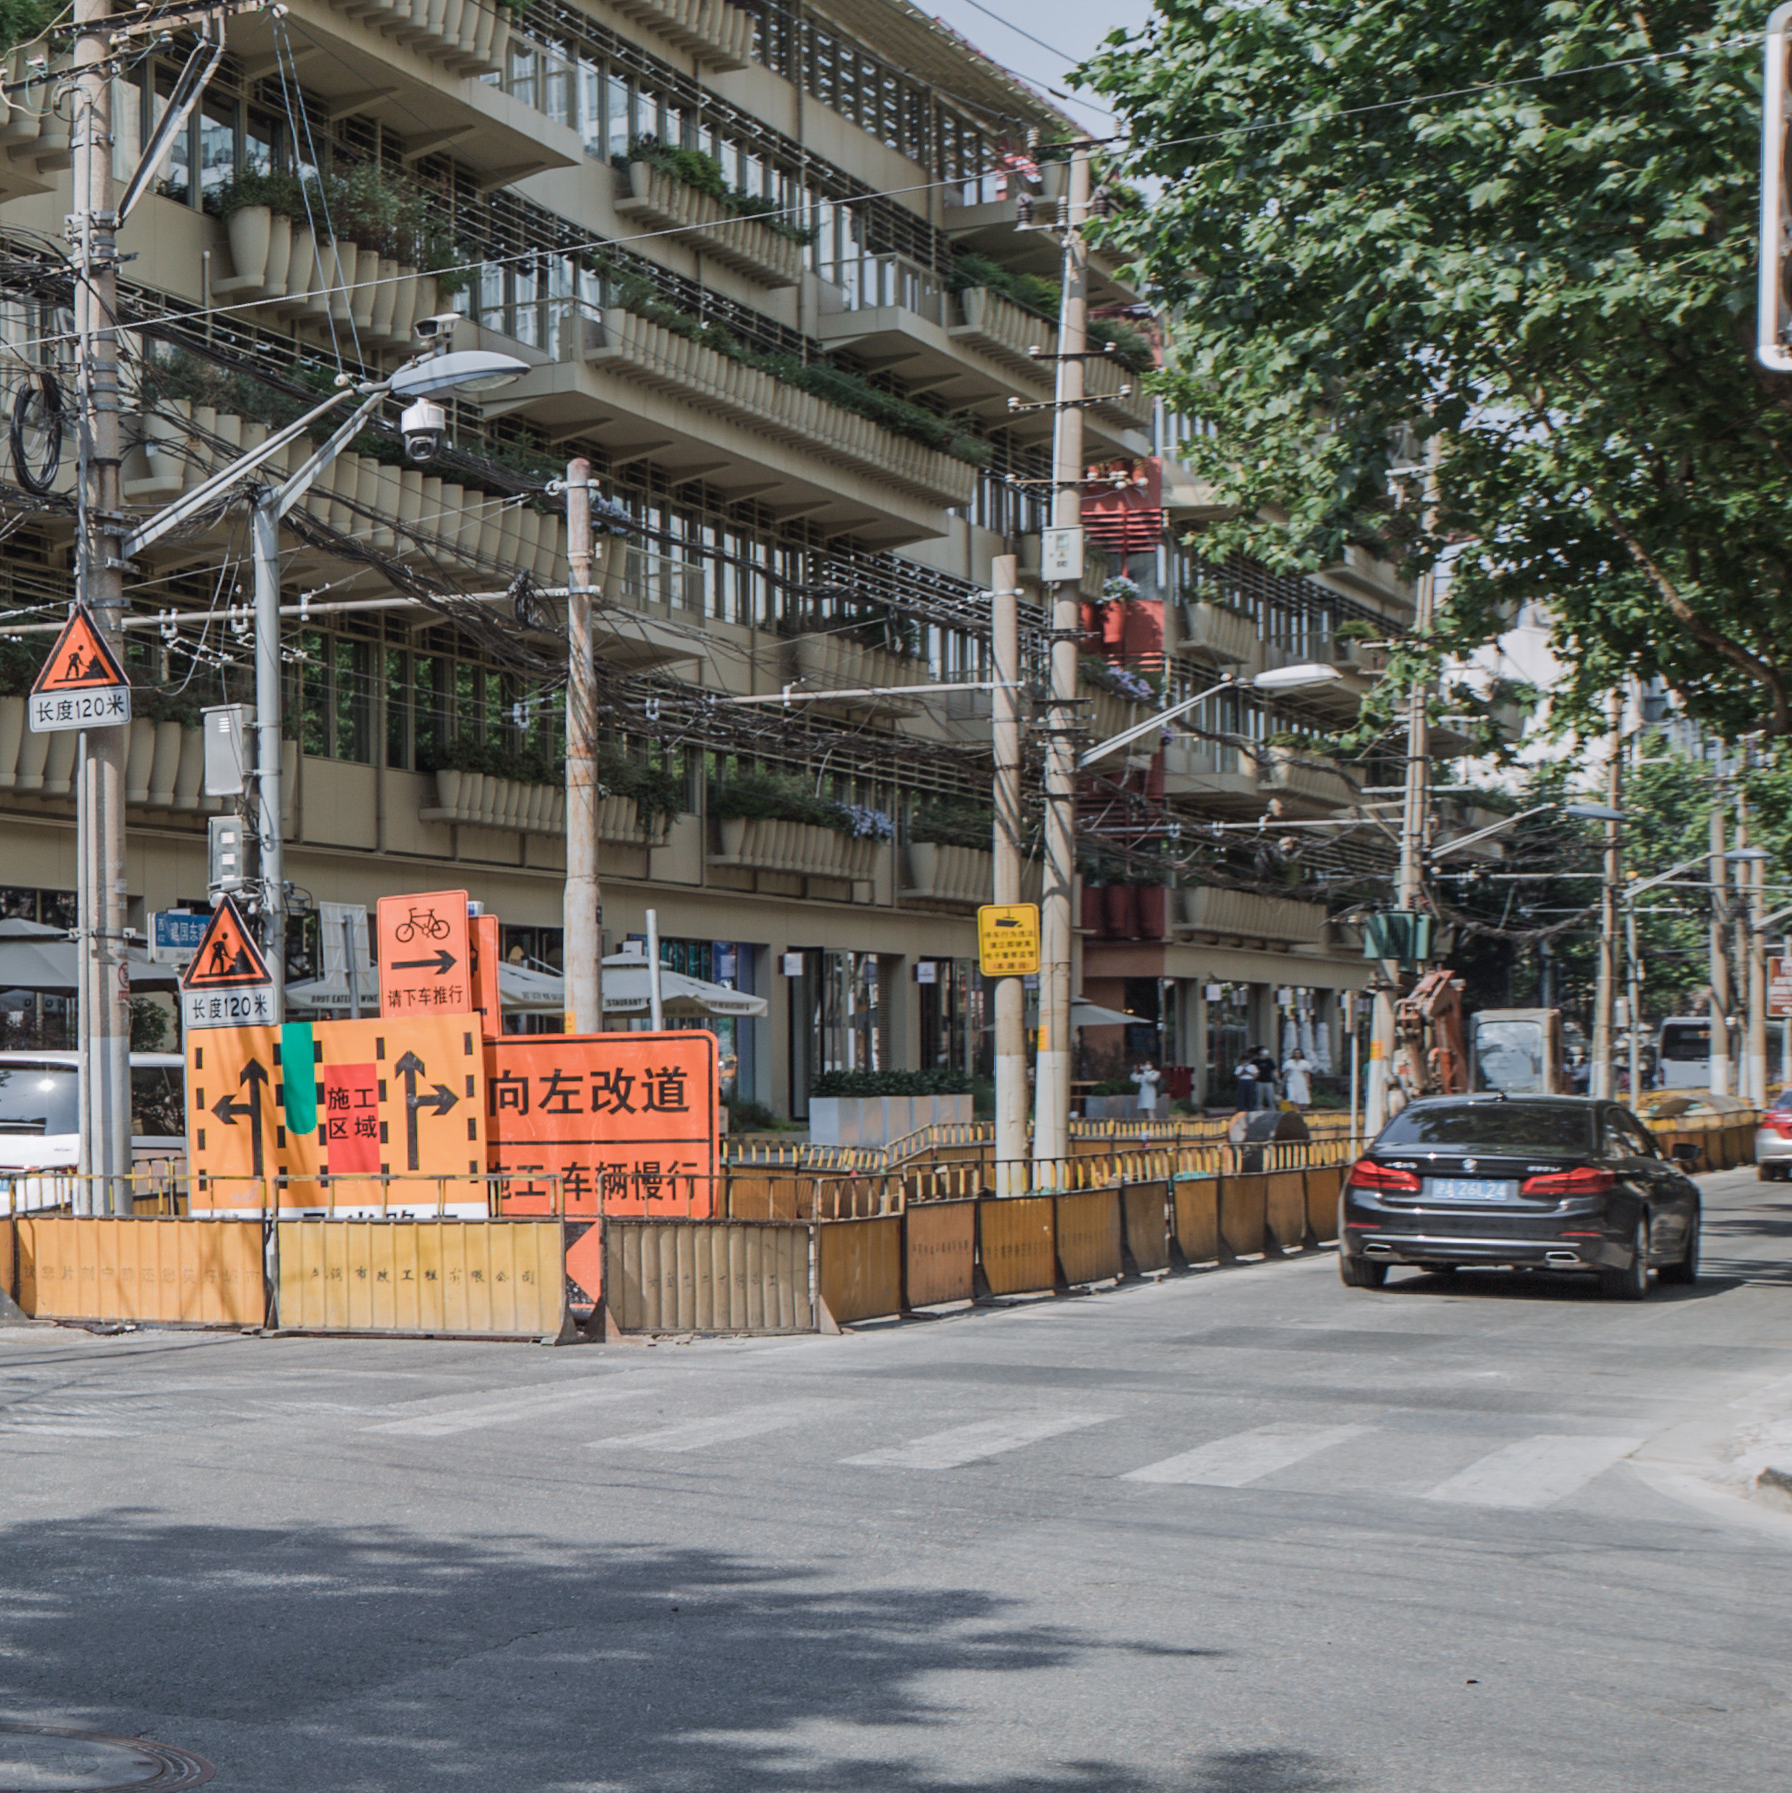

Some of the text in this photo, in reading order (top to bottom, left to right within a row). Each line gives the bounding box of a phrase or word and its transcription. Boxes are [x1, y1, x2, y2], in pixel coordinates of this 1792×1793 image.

[36, 694, 125, 723] 长度120米
[192, 994, 268, 1019] 长度120米
[387, 984, 463, 1008] 请下车推行
[327, 1088, 376, 1111] 施工
[488, 1065, 691, 1117] 向左改道
[329, 1116, 378, 1140] 区域
